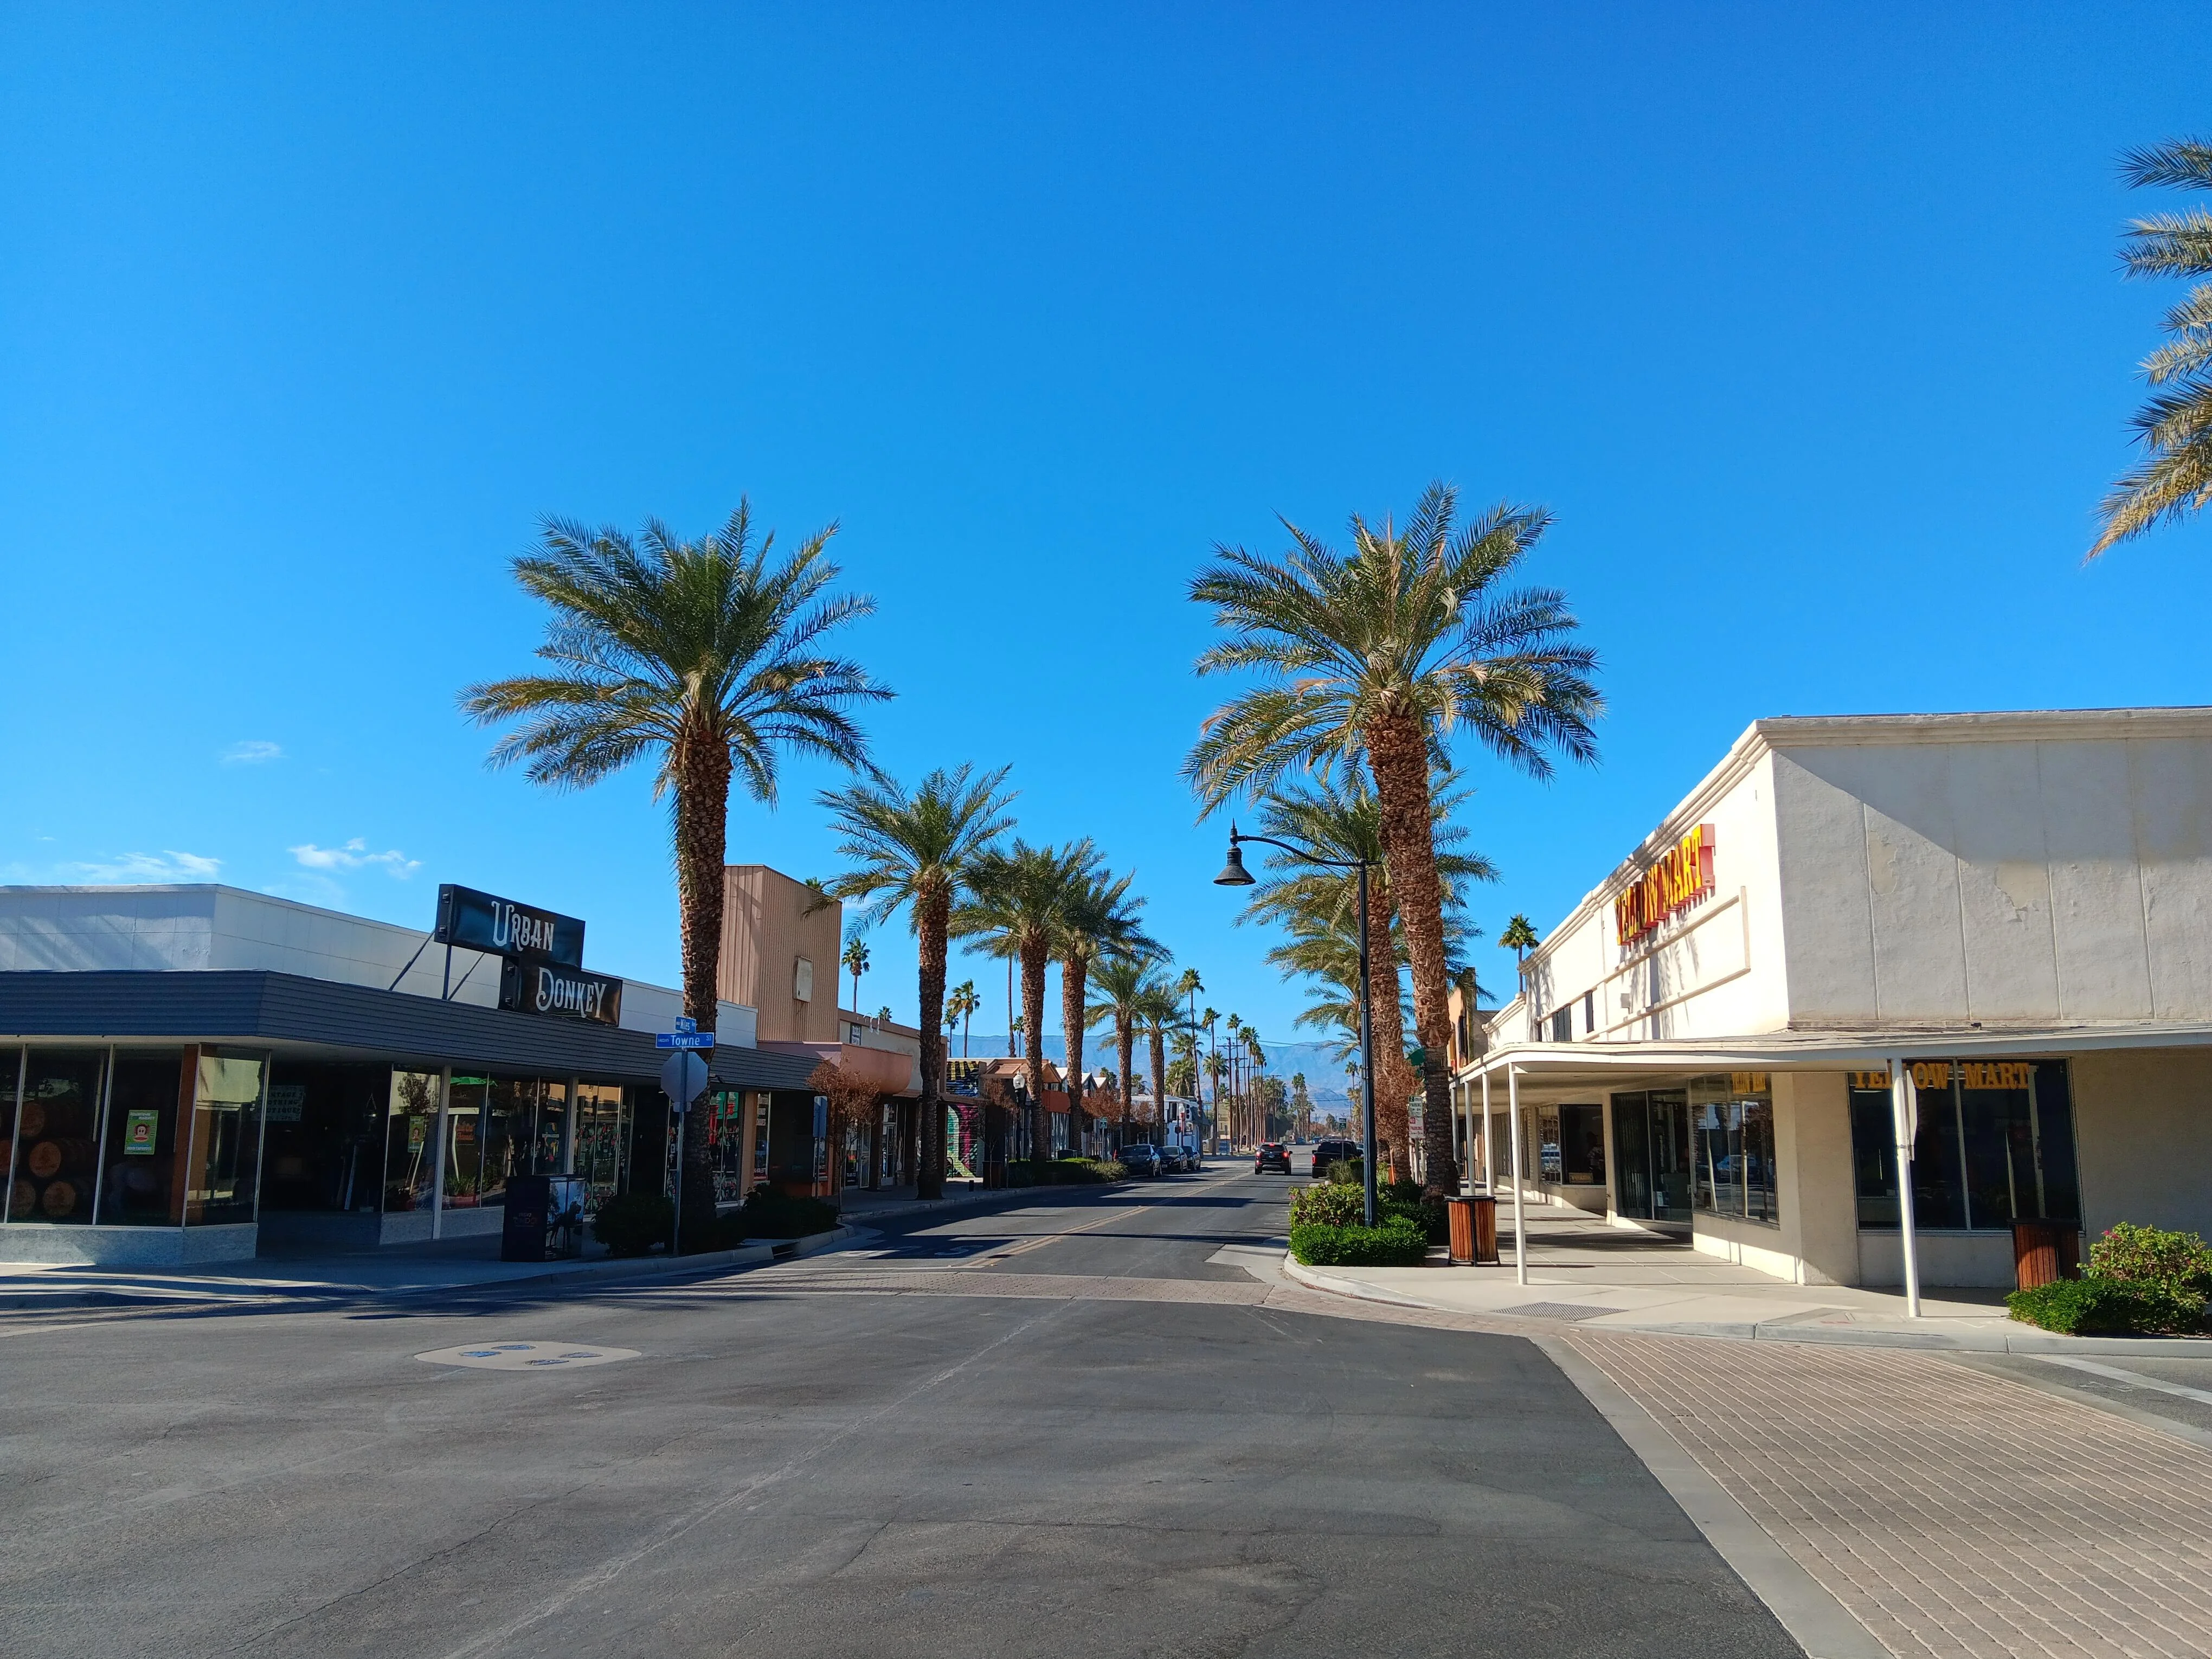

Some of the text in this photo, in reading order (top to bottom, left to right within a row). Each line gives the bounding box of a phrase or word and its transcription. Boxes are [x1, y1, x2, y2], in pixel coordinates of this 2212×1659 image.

[1615, 824, 1703, 946] YELLOW MART
[491, 901, 555, 952] URBAN
[536, 967, 607, 1019] DONKEY
[670, 1034, 700, 1046] Towne
[1962, 1062, 2030, 1090] MART
